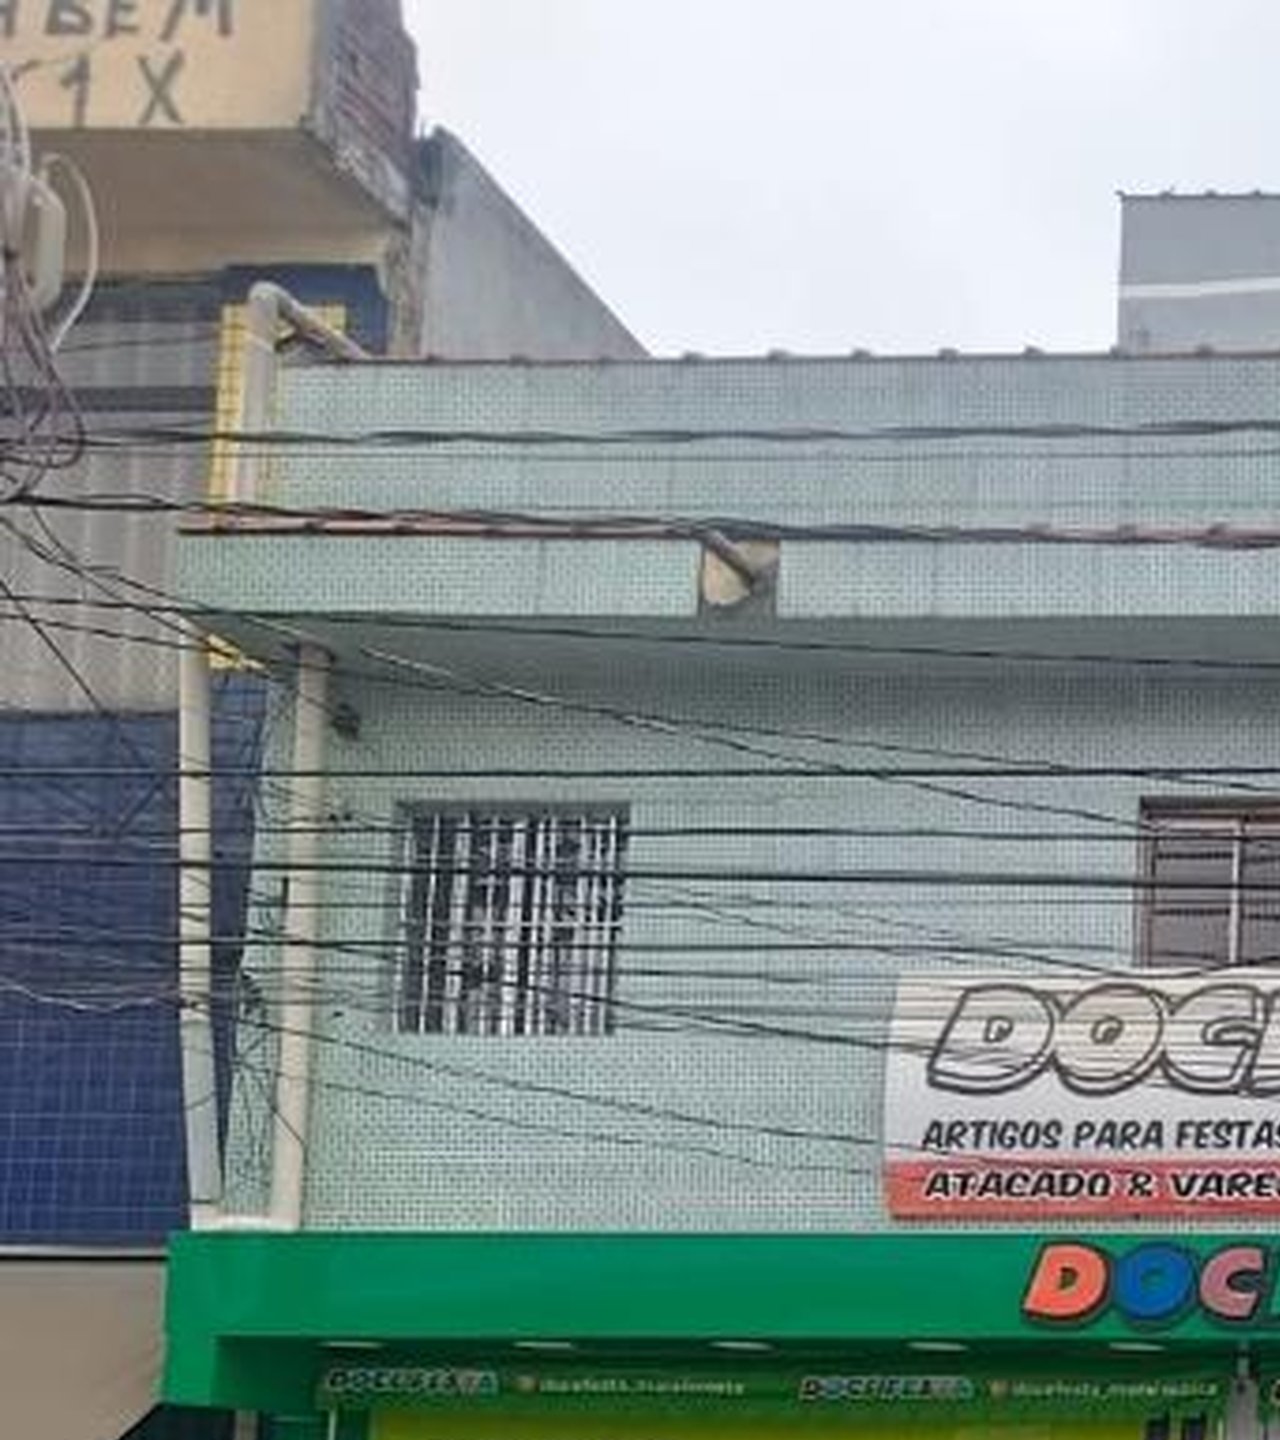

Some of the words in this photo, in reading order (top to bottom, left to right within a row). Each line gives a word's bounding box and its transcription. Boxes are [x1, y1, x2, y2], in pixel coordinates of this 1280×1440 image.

[922, 1119, 1063, 1150] ARTIGOS
[1073, 1120, 1164, 1149] PARA
[924, 1170, 1113, 1198] ATACADO
